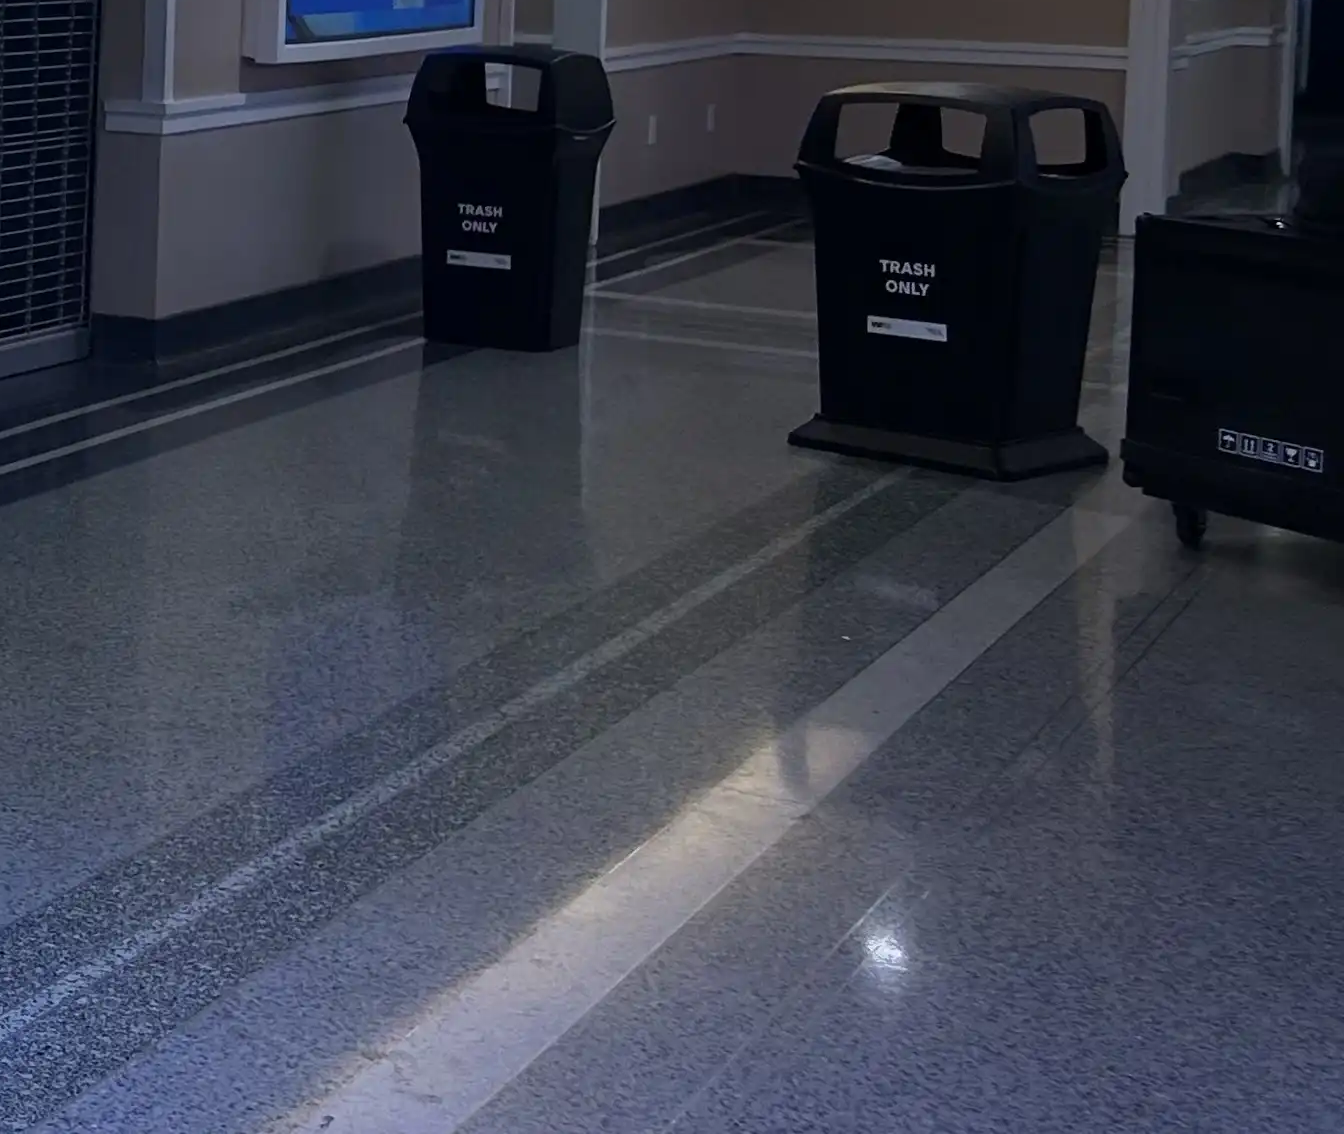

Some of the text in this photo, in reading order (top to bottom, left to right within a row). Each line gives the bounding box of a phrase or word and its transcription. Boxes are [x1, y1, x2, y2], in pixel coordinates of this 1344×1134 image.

[457, 203, 503, 218] TRASH
[462, 219, 499, 234] ONLY
[879, 258, 936, 278] TRASH
[885, 279, 930, 297] ONLY
